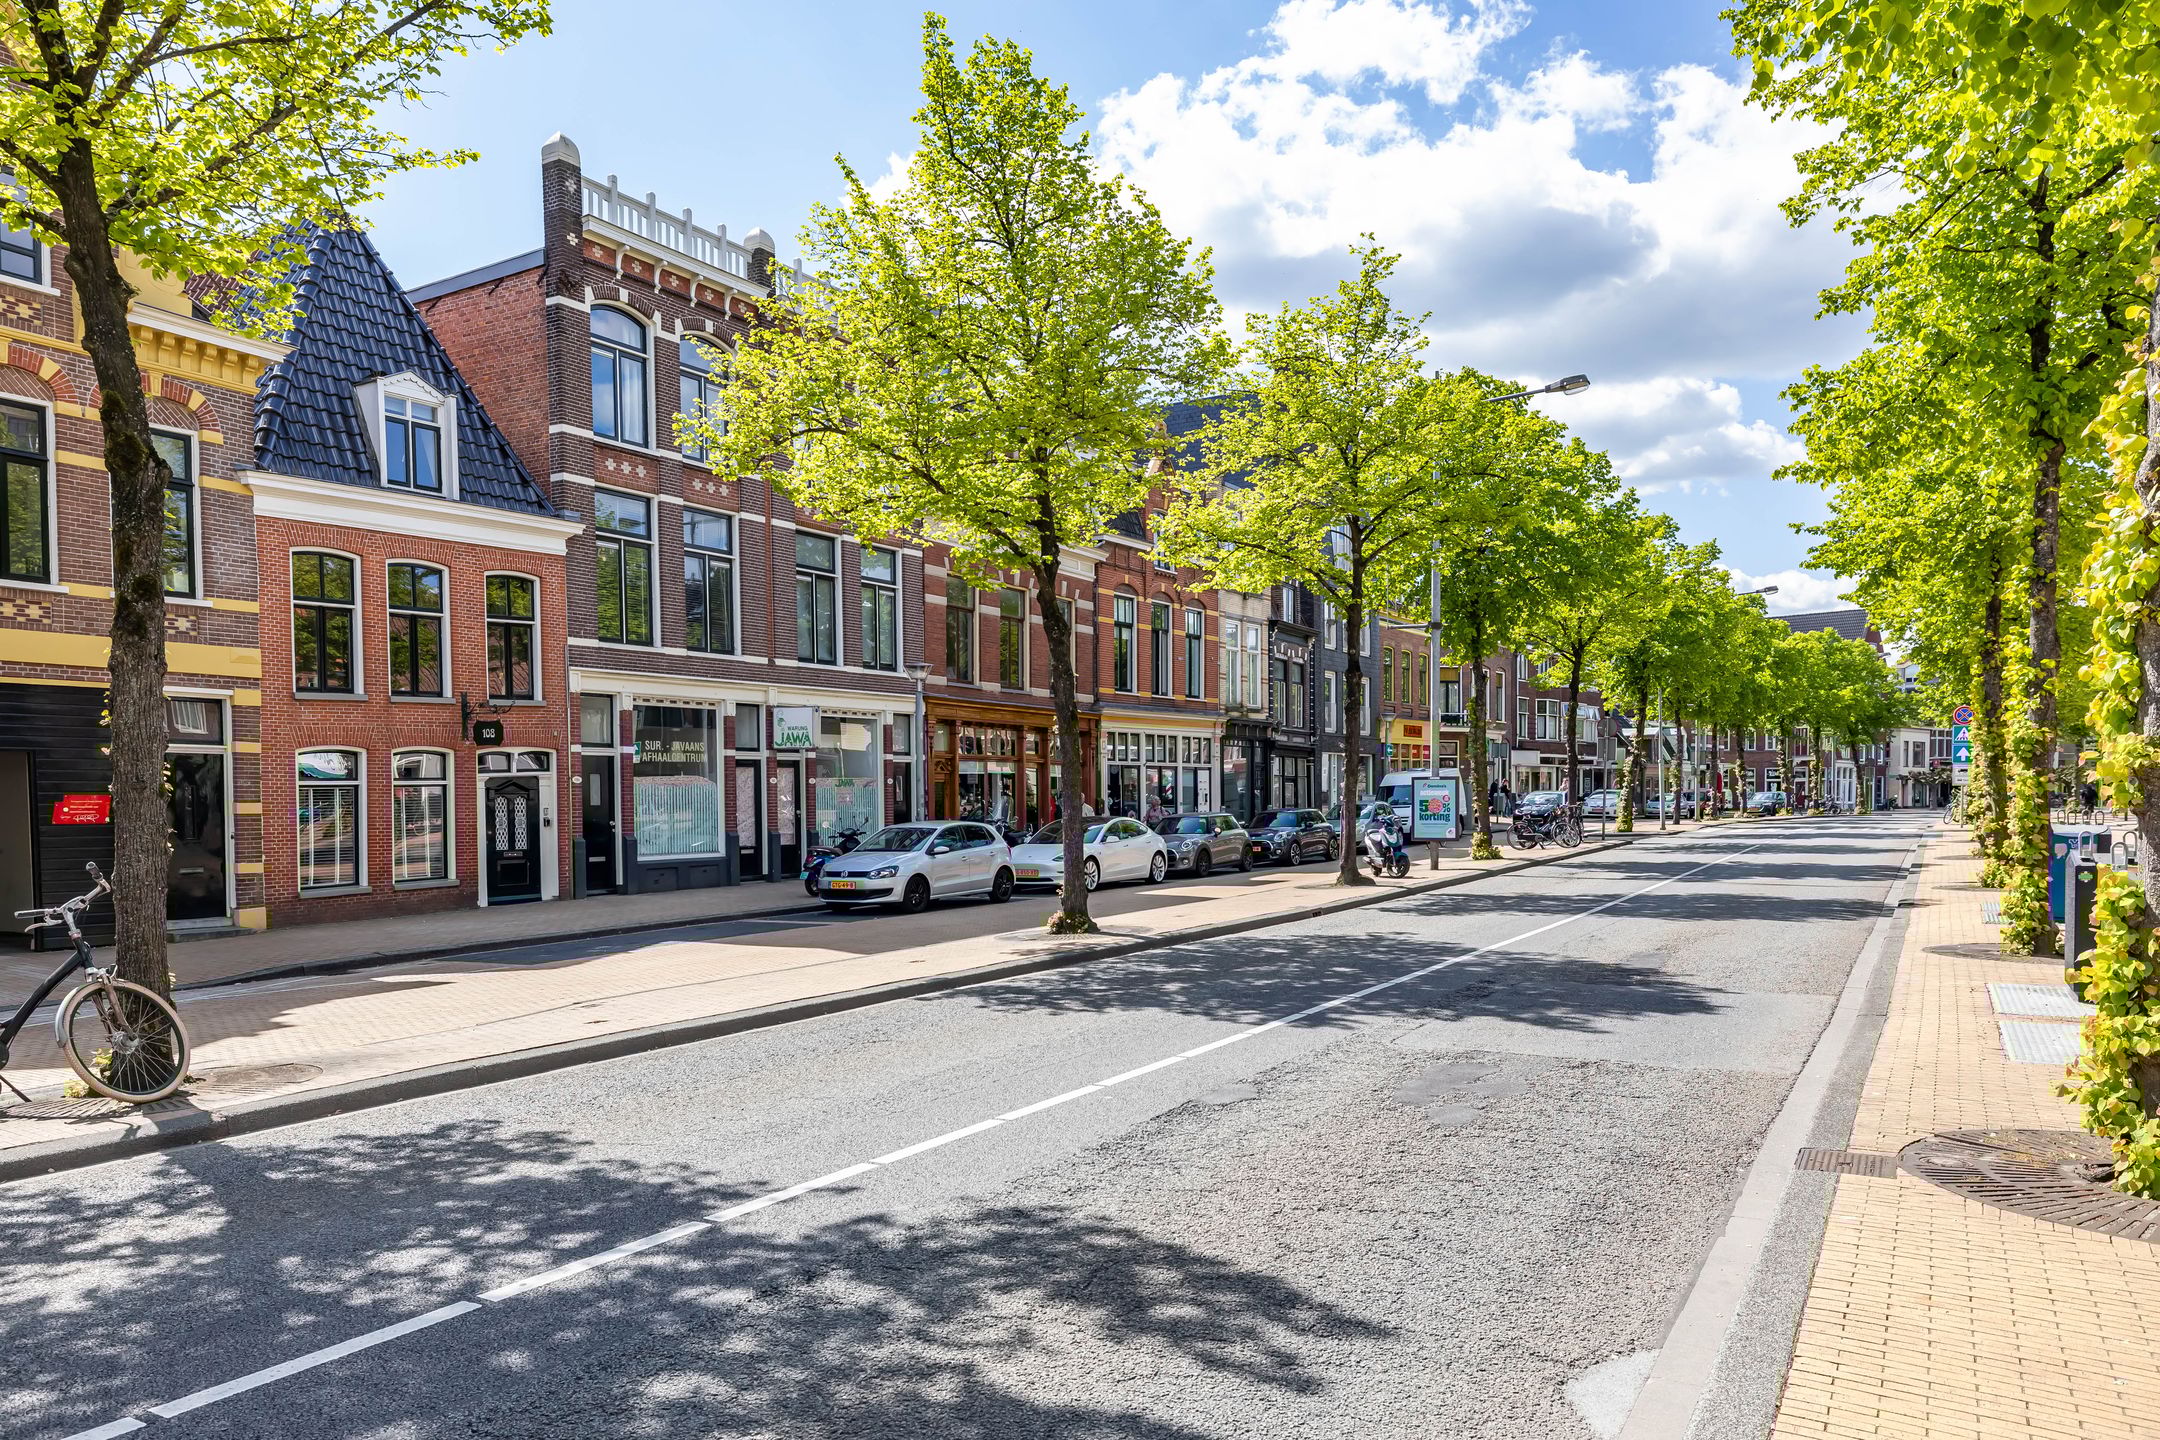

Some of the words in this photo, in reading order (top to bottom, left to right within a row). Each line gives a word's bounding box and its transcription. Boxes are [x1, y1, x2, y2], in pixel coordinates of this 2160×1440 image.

[482, 728, 496, 738] 108
[775, 732, 812, 747] JAWA
[645, 740, 664, 751] SUR.
[671, 742, 705, 751] JAVAANS
[642, 752, 708, 762] AFHAALCENTRUM
[1419, 800, 1451, 812] 5%
[1419, 812, 1451, 822] korting
